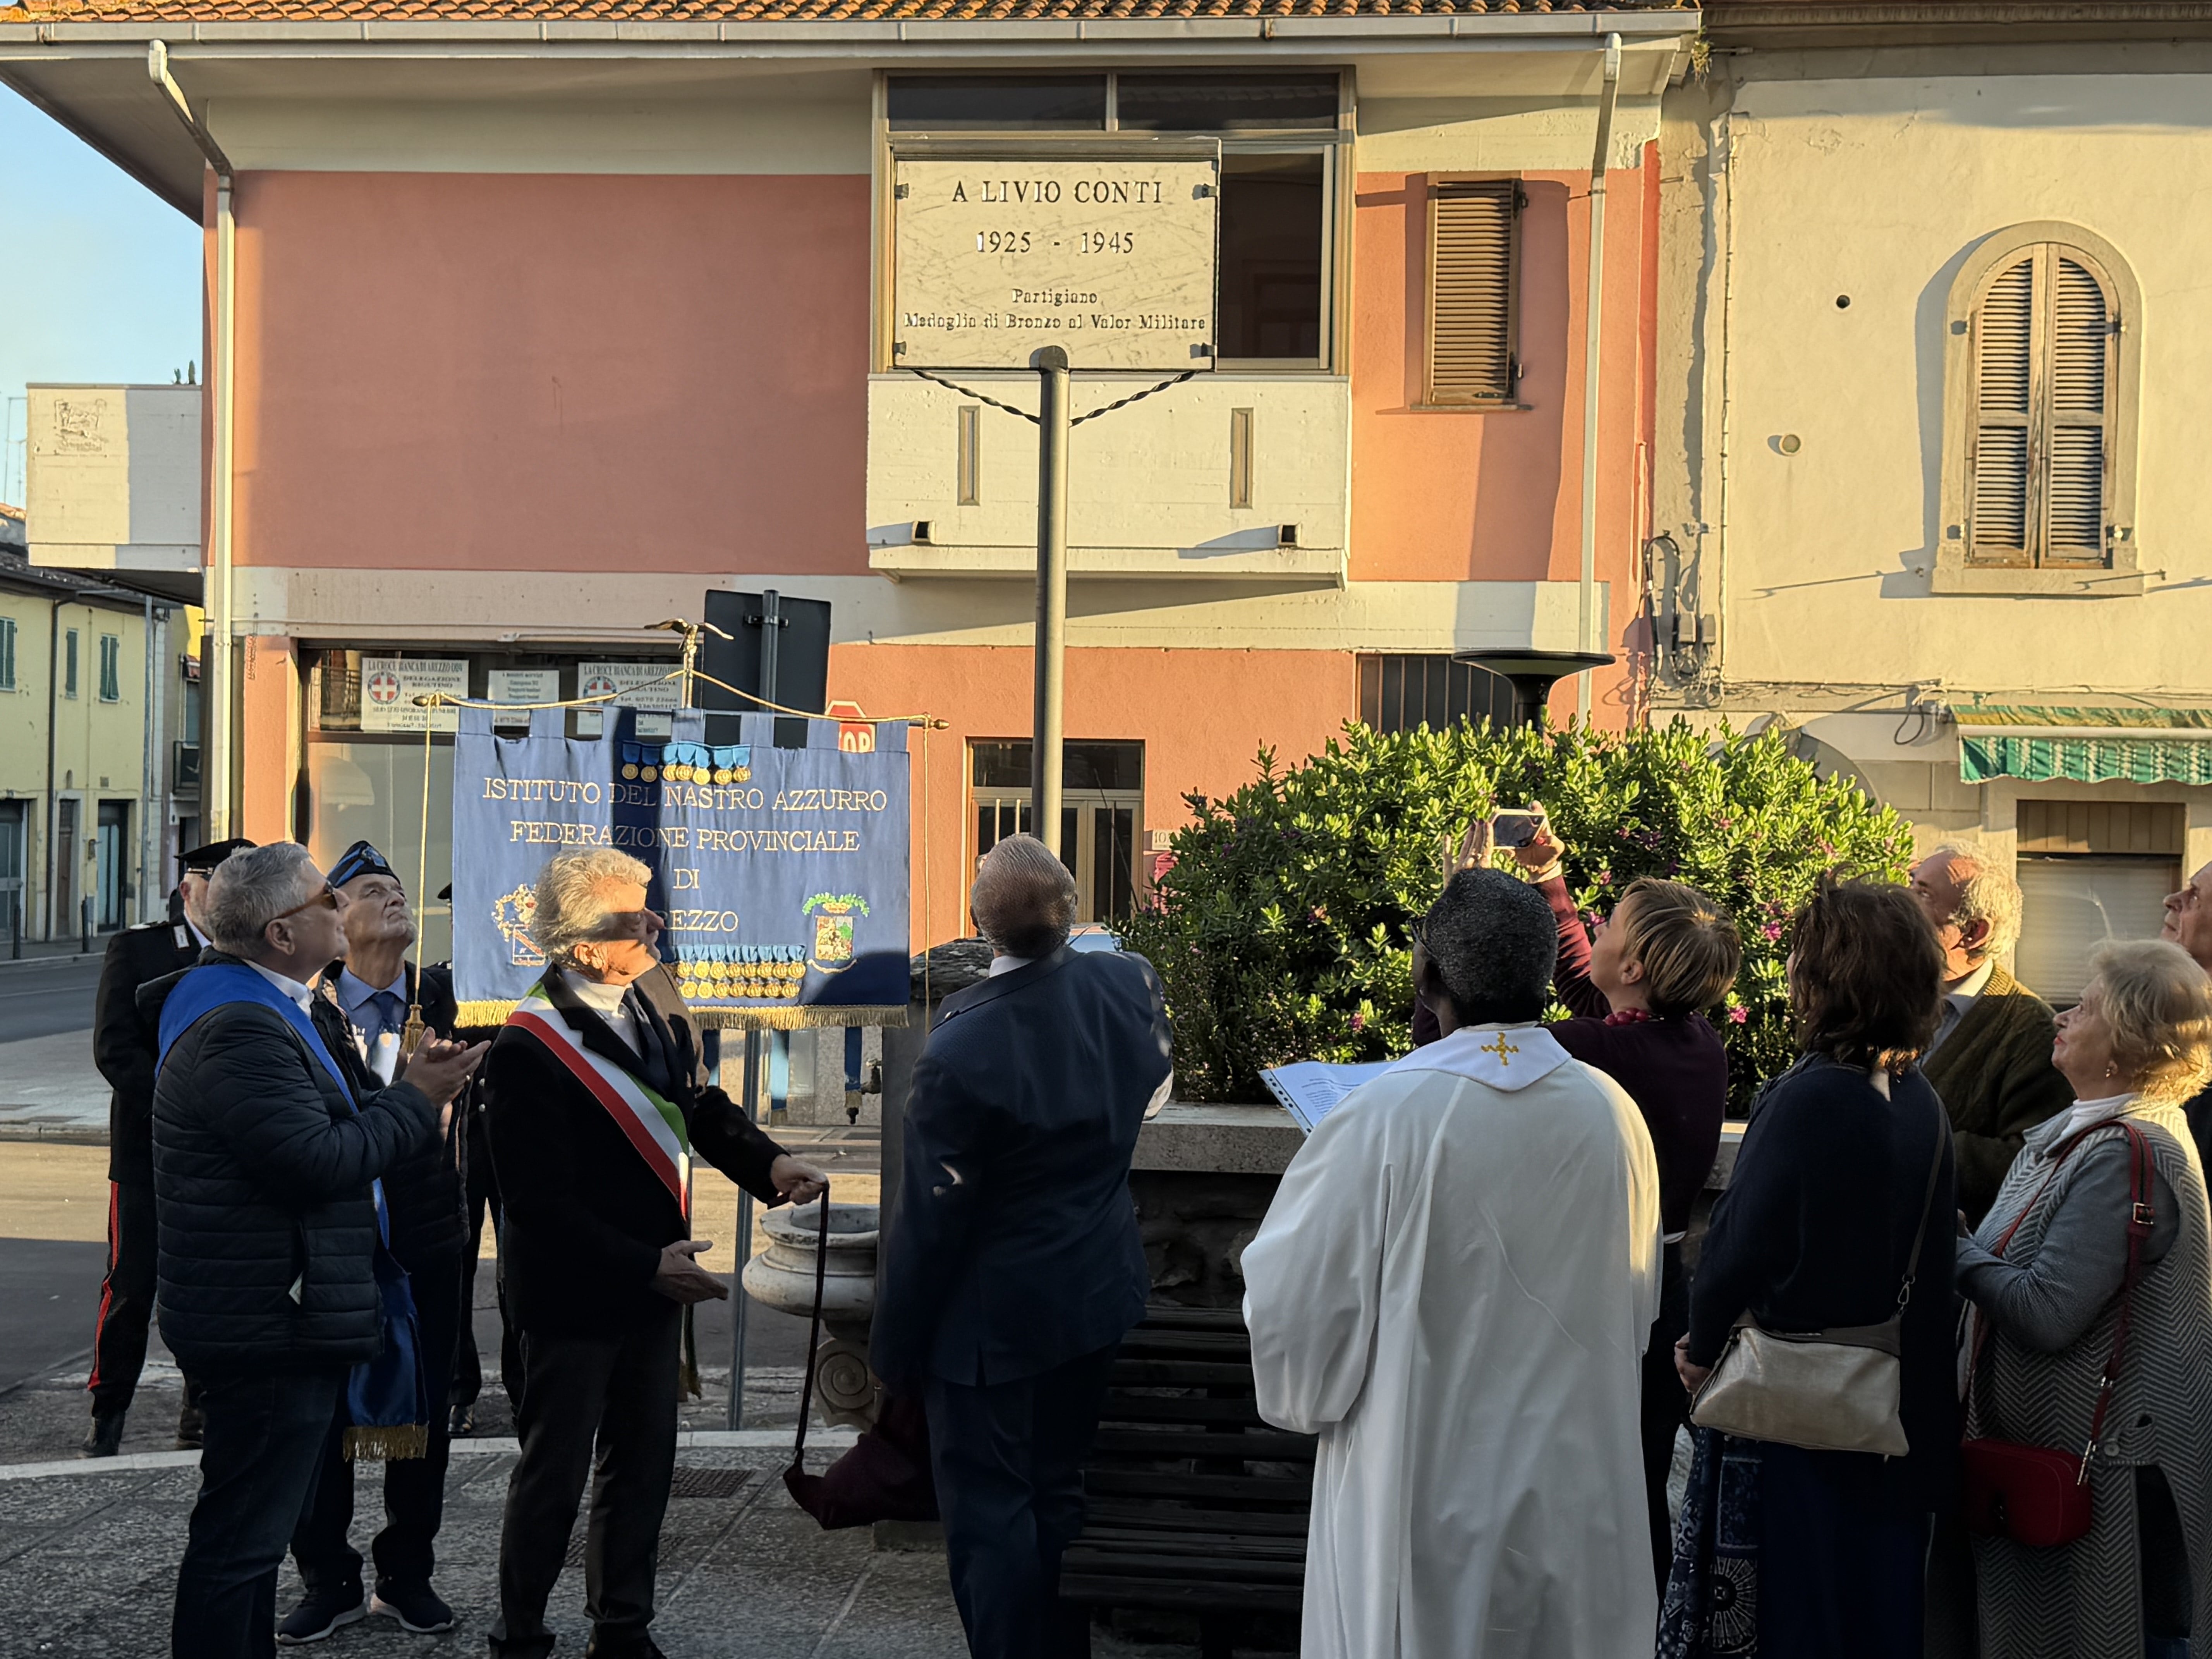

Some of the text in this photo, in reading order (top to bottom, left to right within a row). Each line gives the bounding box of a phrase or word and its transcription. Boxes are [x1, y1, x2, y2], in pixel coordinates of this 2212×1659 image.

[952, 180, 1161, 203] A LIVIO CONTI
[977, 232, 1031, 253] 1925
[1081, 232, 1133, 253] 1945
[1012, 289, 1097, 306] Partigiano
[904, 313, 1205, 330] Medaglia di Bronzo al Valor Militare
[483, 777, 888, 811] ISTITUTO DEL NASTRO AZZURRO
[509, 821, 860, 852] FEDERAZIONE PROVINCIALE
[1154, 831, 1172, 843] 10
[673, 868, 700, 889] DI
[655, 910, 738, 932] EZZO
